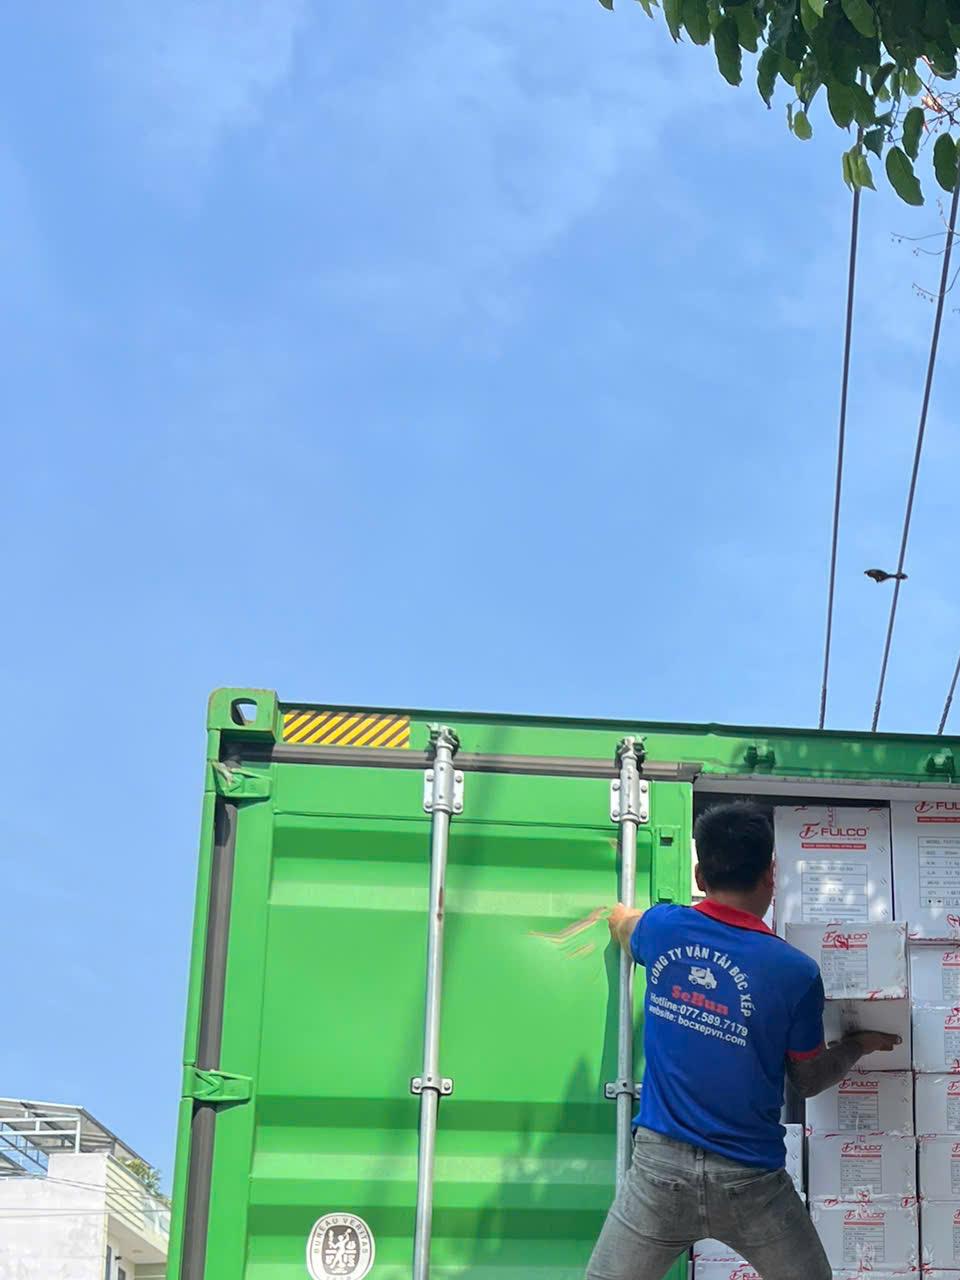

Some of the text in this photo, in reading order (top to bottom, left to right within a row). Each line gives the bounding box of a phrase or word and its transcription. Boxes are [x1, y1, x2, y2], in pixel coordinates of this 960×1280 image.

[821, 827, 867, 837] FULCO
[651, 944, 756, 1018] CÔNG TY VẬN TẢI BỐC XẾP
[678, 1017, 747, 1047] bocxepvn.com
